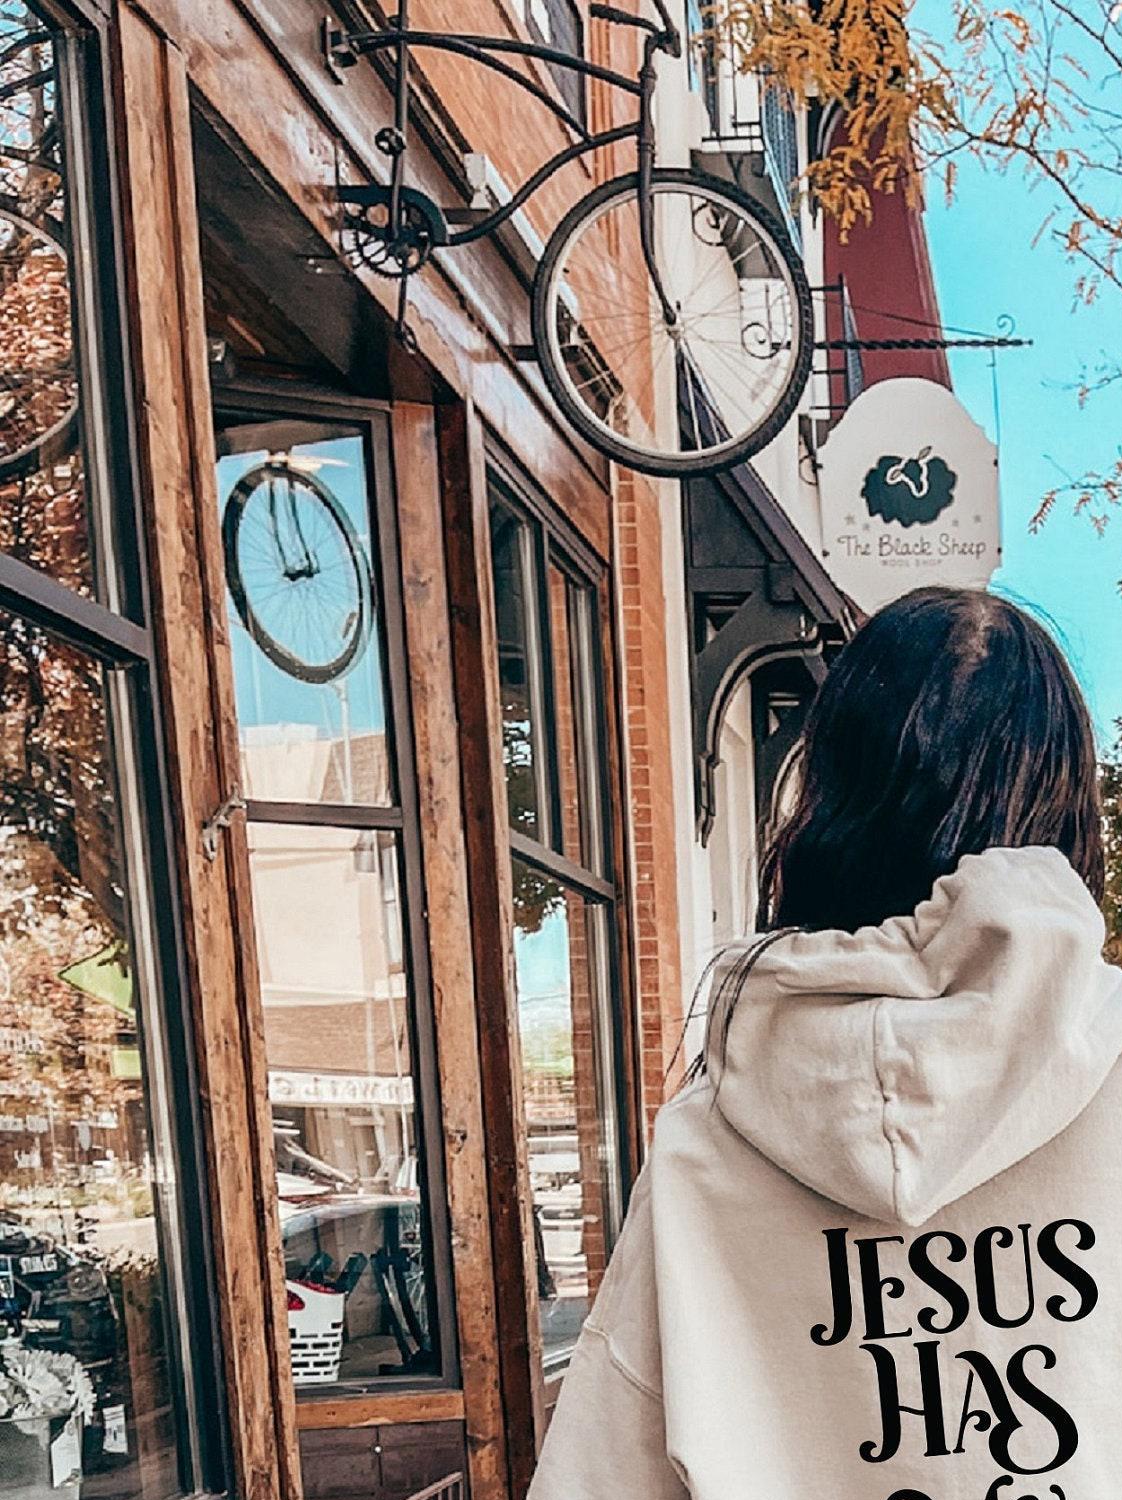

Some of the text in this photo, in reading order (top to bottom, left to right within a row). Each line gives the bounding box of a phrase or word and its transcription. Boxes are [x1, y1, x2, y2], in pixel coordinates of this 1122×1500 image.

[837, 533, 986, 559] The Black Sheep
[810, 1218, 1098, 1346] JESUS
[859, 1340, 1079, 1475] HAS
